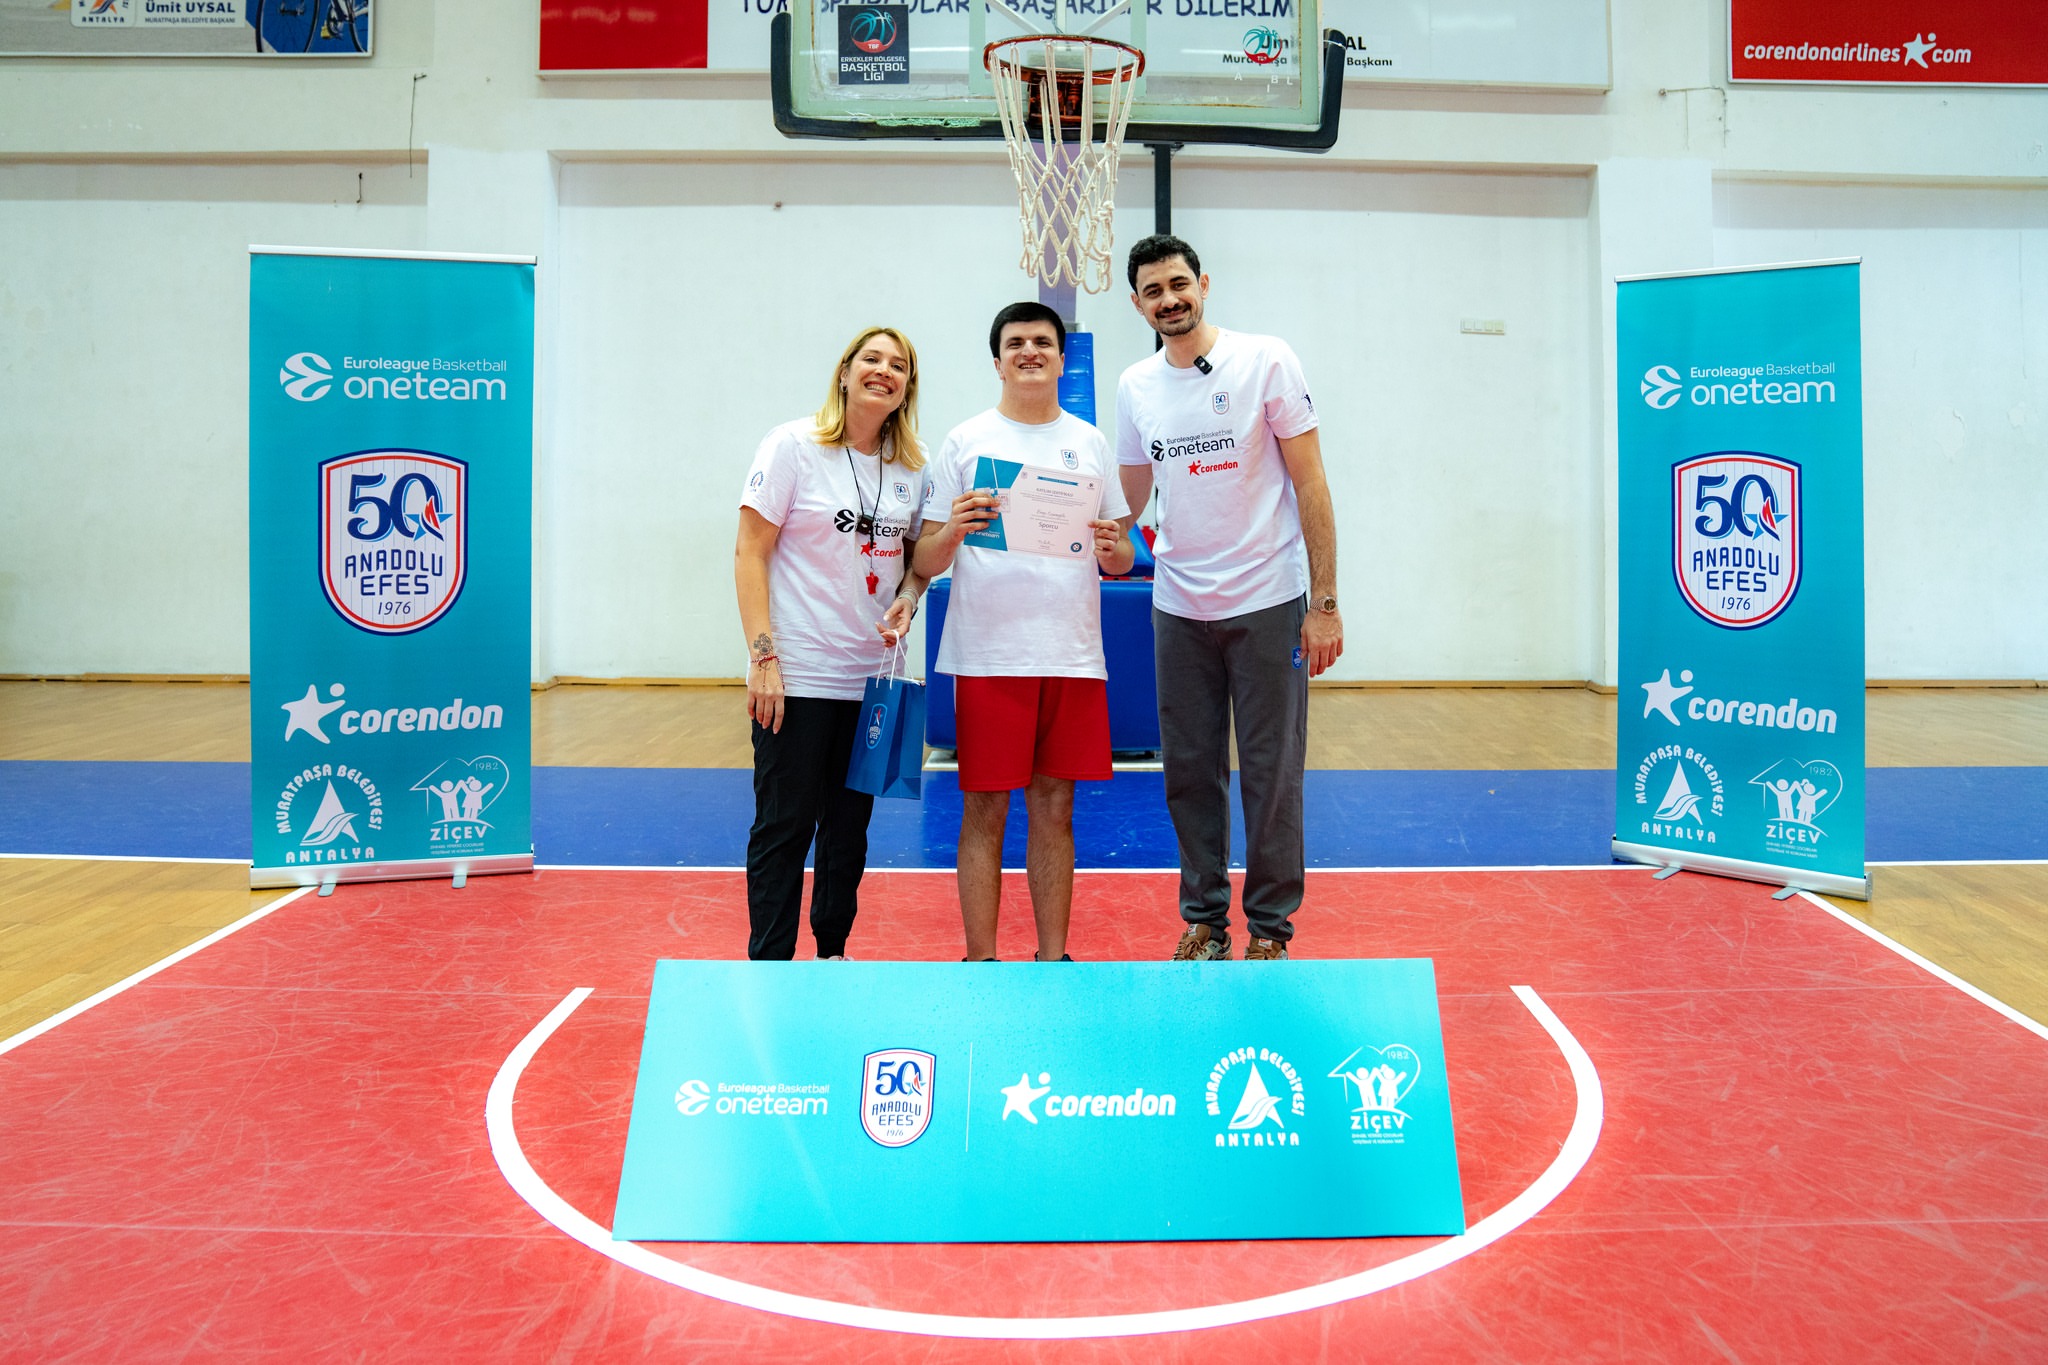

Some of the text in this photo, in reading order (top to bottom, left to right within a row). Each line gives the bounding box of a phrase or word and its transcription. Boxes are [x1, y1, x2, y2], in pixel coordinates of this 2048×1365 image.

[146, 0, 236, 13] Ümit UYSAL
[1346, 57, 1392, 67] Başkanı
[1743, 42, 1901, 63] corendonairlines
[841, 62, 907, 72] BASKETBOL
[863, 70, 885, 81] LİGİ
[343, 356, 507, 373] Euroleague Basketball
[1690, 362, 1835, 379] Euroleague Basketball
[343, 372, 507, 400] oneteam
[1690, 378, 1836, 406] oneteam
[1166, 434, 1201, 445] Euroleague
[1168, 437, 1235, 458] oneteam
[1200, 460, 1239, 473] corendon
[347, 472, 445, 543] 50
[1694, 473, 1779, 541] 50
[1038, 521, 1059, 531] Sporcu
[344, 549, 444, 579] ANADOLU
[1693, 547, 1779, 576] ANADOLU
[360, 574, 429, 596] EFES
[1706, 571, 1767, 592] EFES
[377, 601, 412, 616] 1976
[1721, 597, 1751, 610] 1976
[339, 698, 503, 735] corendon
[1688, 697, 1837, 734] corendon
[475, 762, 499, 771] 1982
[1809, 766, 1833, 777] 1982
[1634, 744, 1724, 817] MURATPAŞA BELEDİYESİ
[275, 763, 383, 834] MURATPAŞA BELEDİYESİ
[430, 824, 487, 843] ZİÇEV
[1641, 821, 1716, 843] ANTALYA
[1765, 822, 1821, 844] ZİÇEV
[285, 846, 375, 864] ANTALYA
[1386, 1050, 1410, 1060] 1982
[875, 1060, 922, 1096] 50
[1205, 1046, 1305, 1116] MURATPAŞA BELEDİYESİ
[717, 1083, 830, 1095] Euroleague Basketball
[715, 1094, 829, 1115] oneteam
[871, 1100, 921, 1118] ANADOLU
[1044, 1088, 1177, 1117] corendon
[878, 1114, 914, 1127] EFES
[1350, 1111, 1406, 1133] ZİÇEV
[885, 1129, 904, 1138] 1976
[1215, 1132, 1300, 1147] ANTALYA
